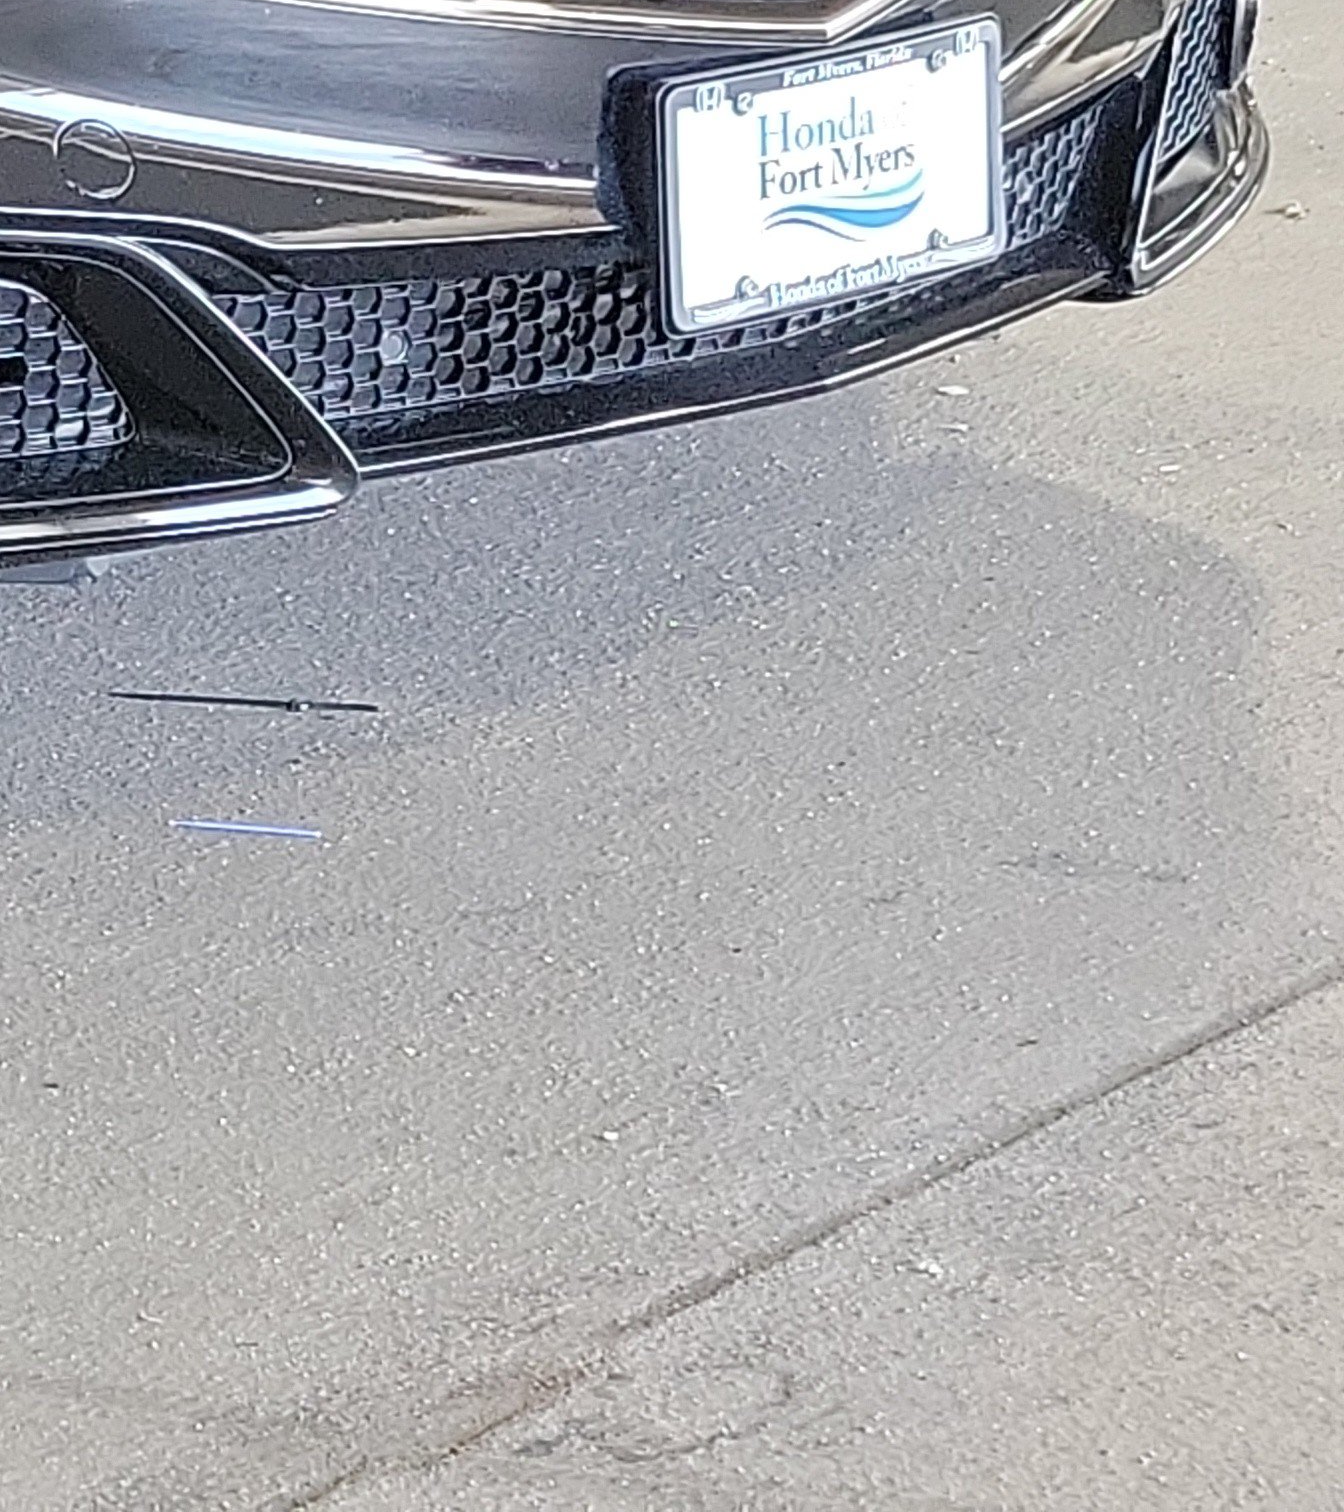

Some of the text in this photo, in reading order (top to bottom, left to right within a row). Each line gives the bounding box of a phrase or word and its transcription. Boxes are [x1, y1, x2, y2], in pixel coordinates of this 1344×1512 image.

[757, 95, 875, 157] Honda
[758, 141, 916, 201] Fort Myers
